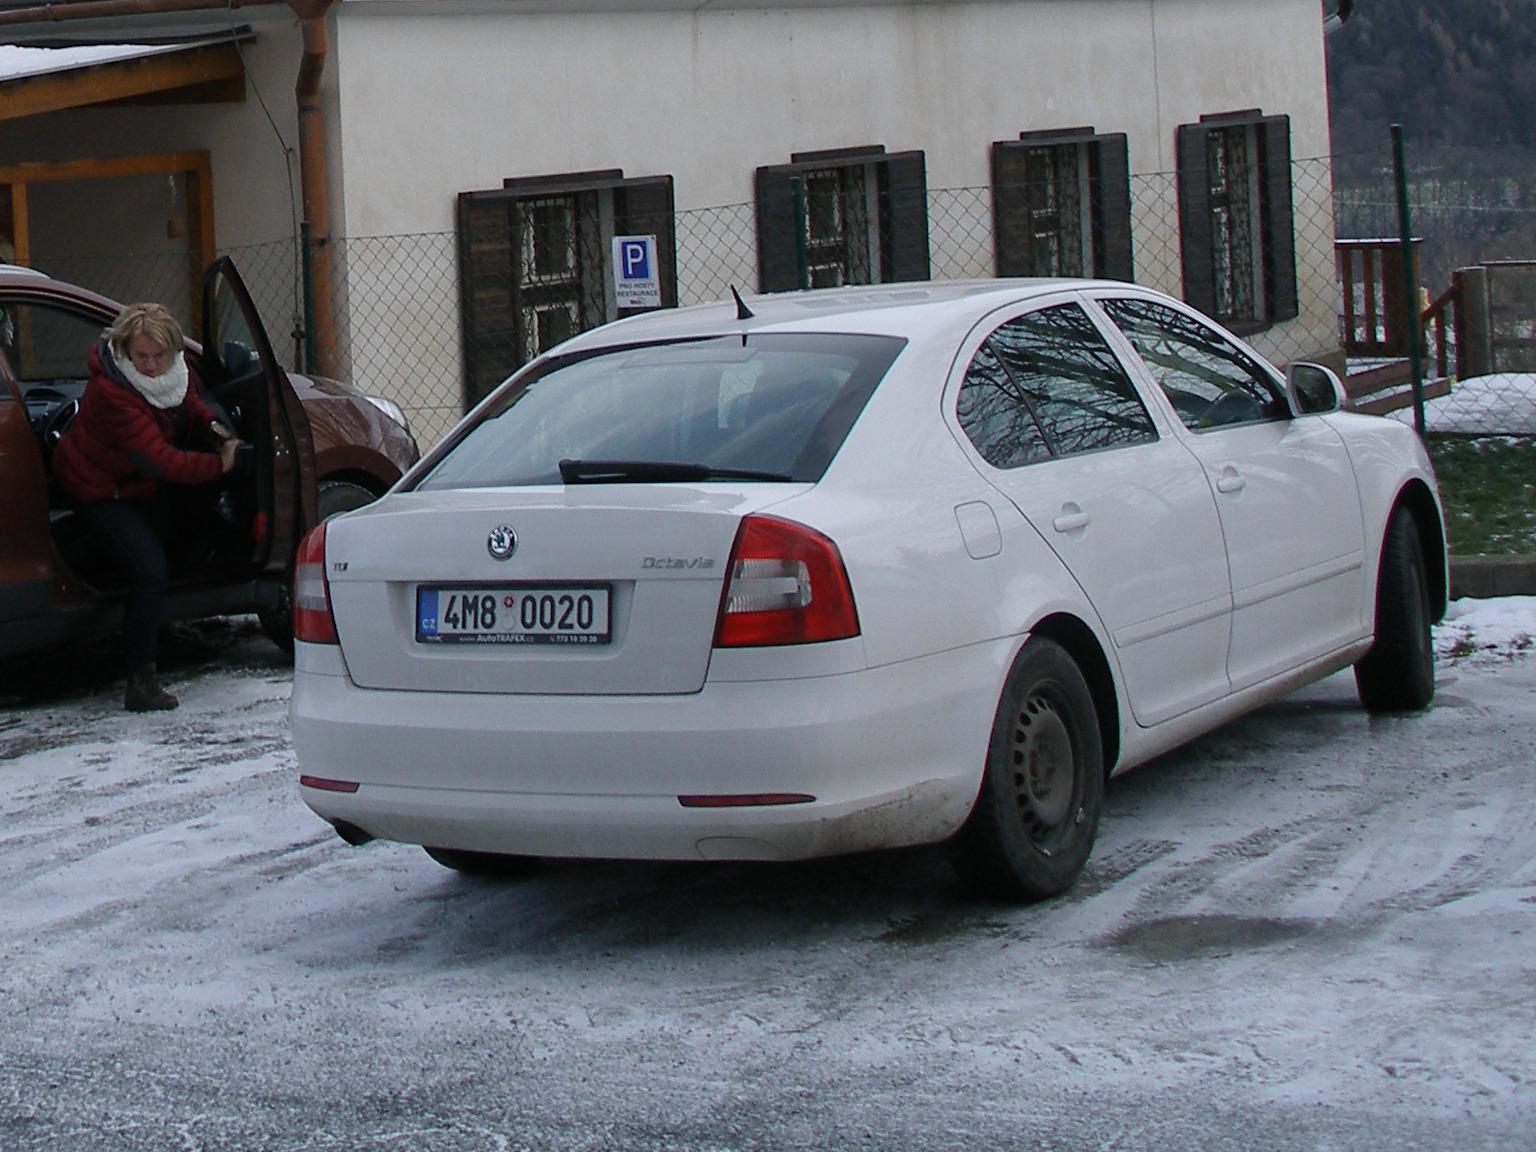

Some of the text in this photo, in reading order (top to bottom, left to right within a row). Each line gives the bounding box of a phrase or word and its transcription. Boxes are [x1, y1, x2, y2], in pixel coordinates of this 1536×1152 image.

[627, 244, 644, 275] P
[642, 556, 715, 569] Octavia
[444, 594, 594, 630] 4M8 0020
[422, 619, 437, 630] CZ
